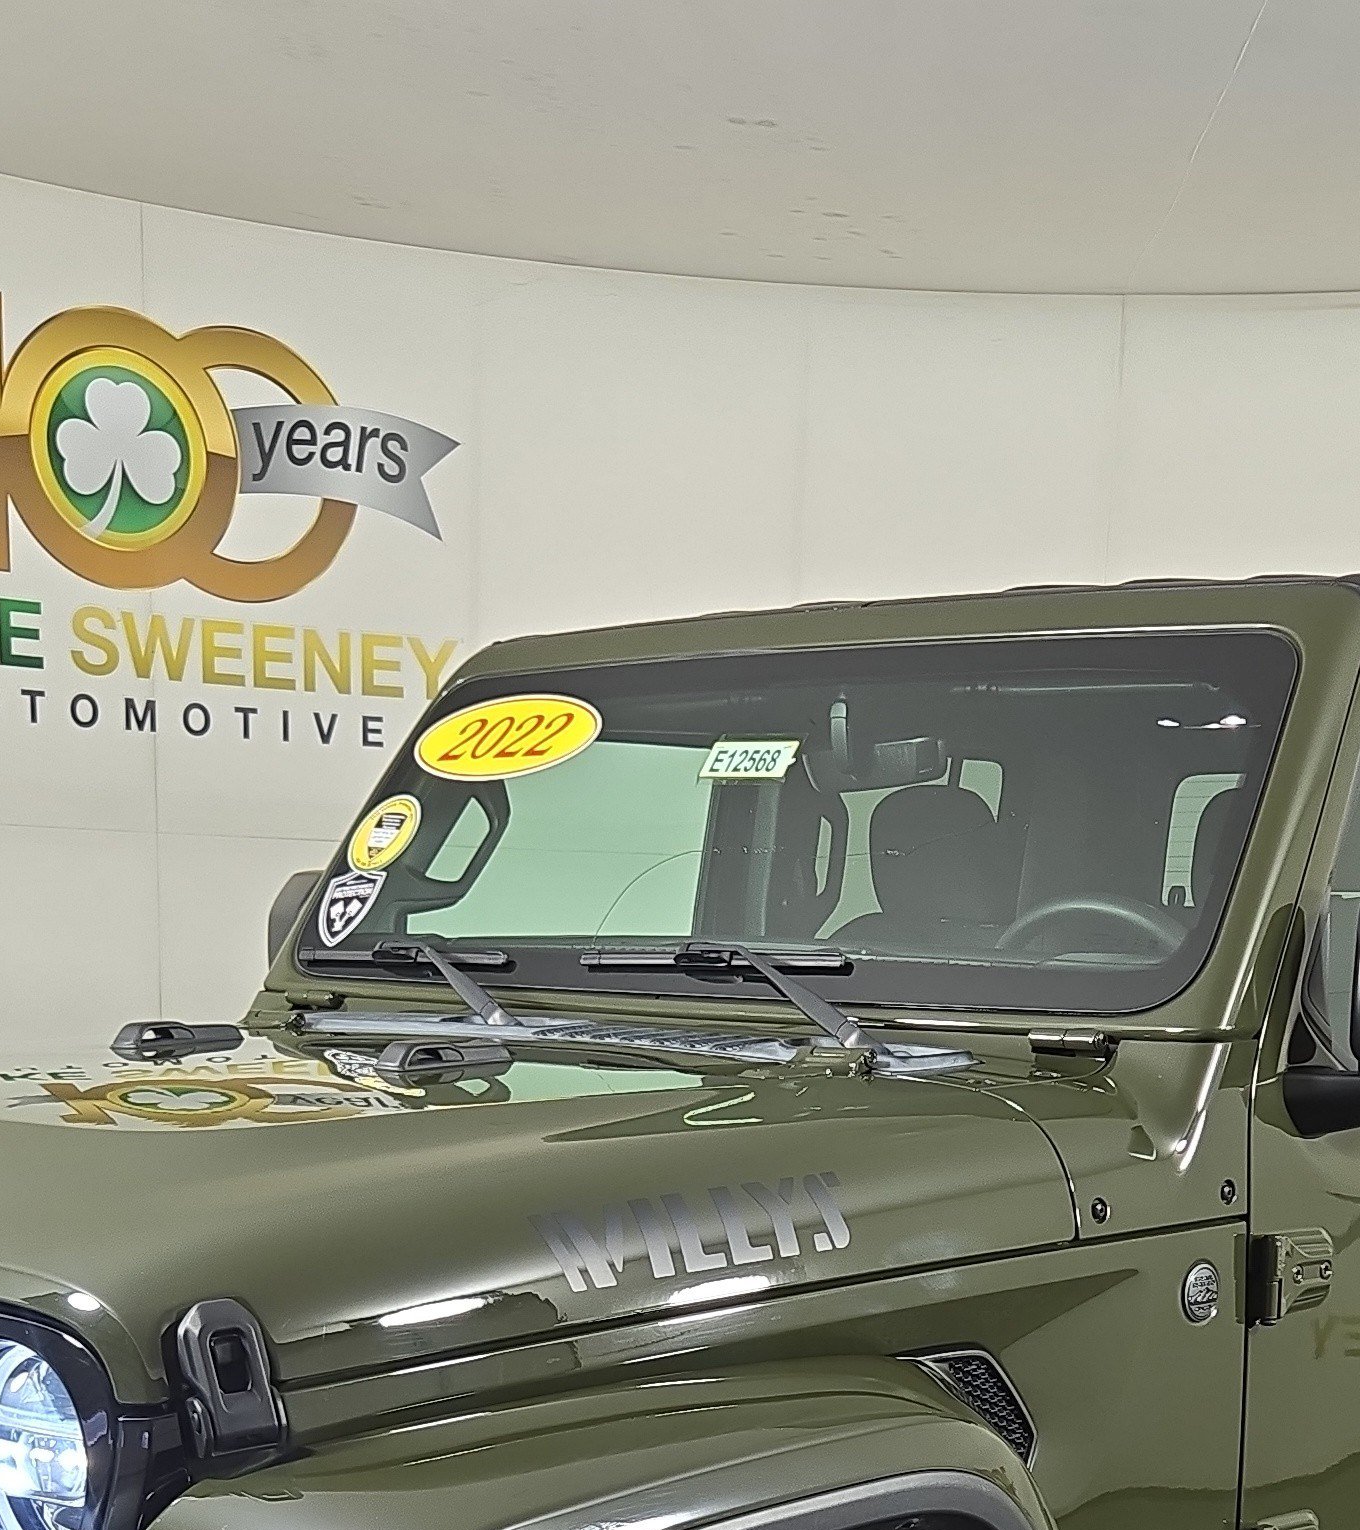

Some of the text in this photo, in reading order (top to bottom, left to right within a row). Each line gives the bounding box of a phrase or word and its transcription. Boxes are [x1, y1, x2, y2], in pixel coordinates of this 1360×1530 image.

[250, 416, 410, 484] years
[70, 606, 458, 701] SWEENEY
[437, 711, 575, 762] 2022
[708, 746, 783, 773] E12568
[527, 1170, 851, 1293] WILLYS
